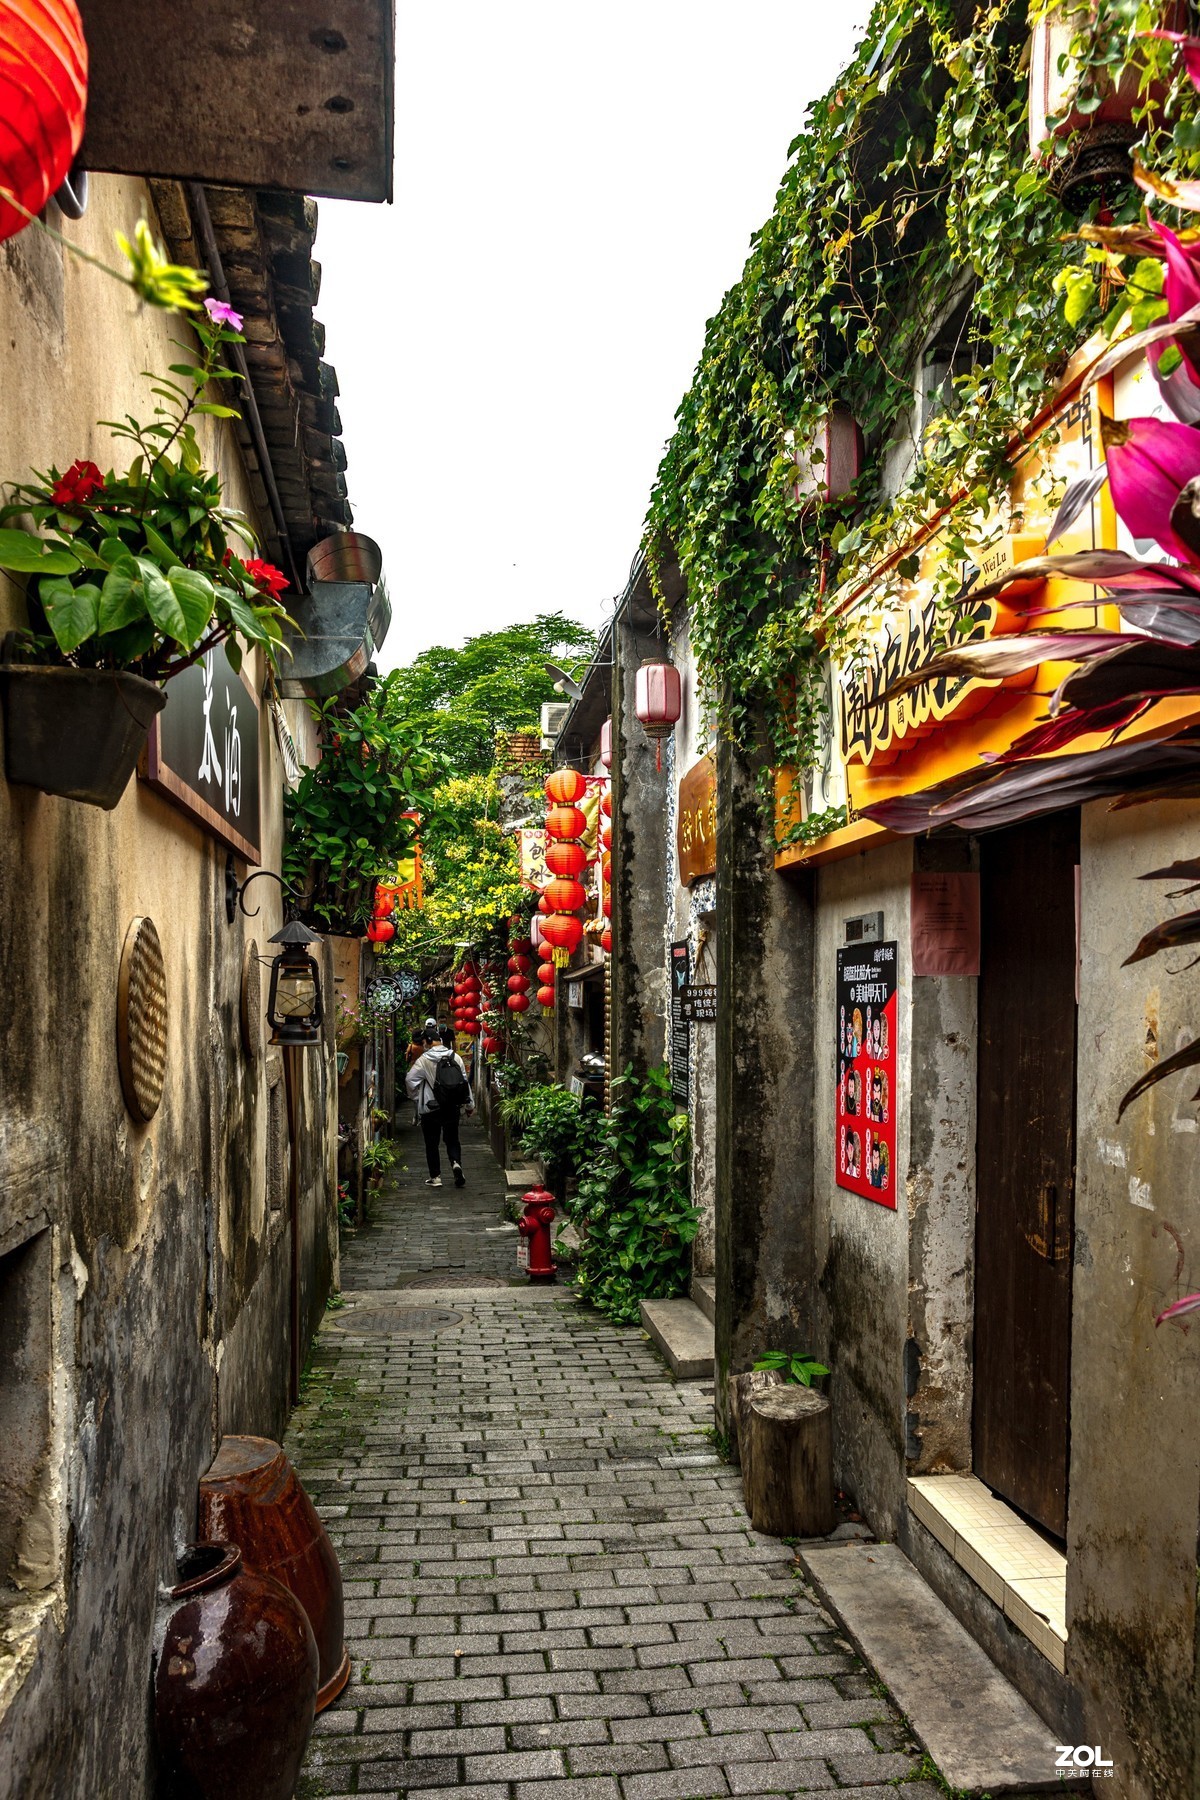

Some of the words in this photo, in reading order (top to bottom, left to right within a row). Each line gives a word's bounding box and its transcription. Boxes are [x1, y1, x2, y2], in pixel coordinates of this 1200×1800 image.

[855, 983, 887, 1003] 美味甲天下
[695, 1008, 717, 1018] 现场
